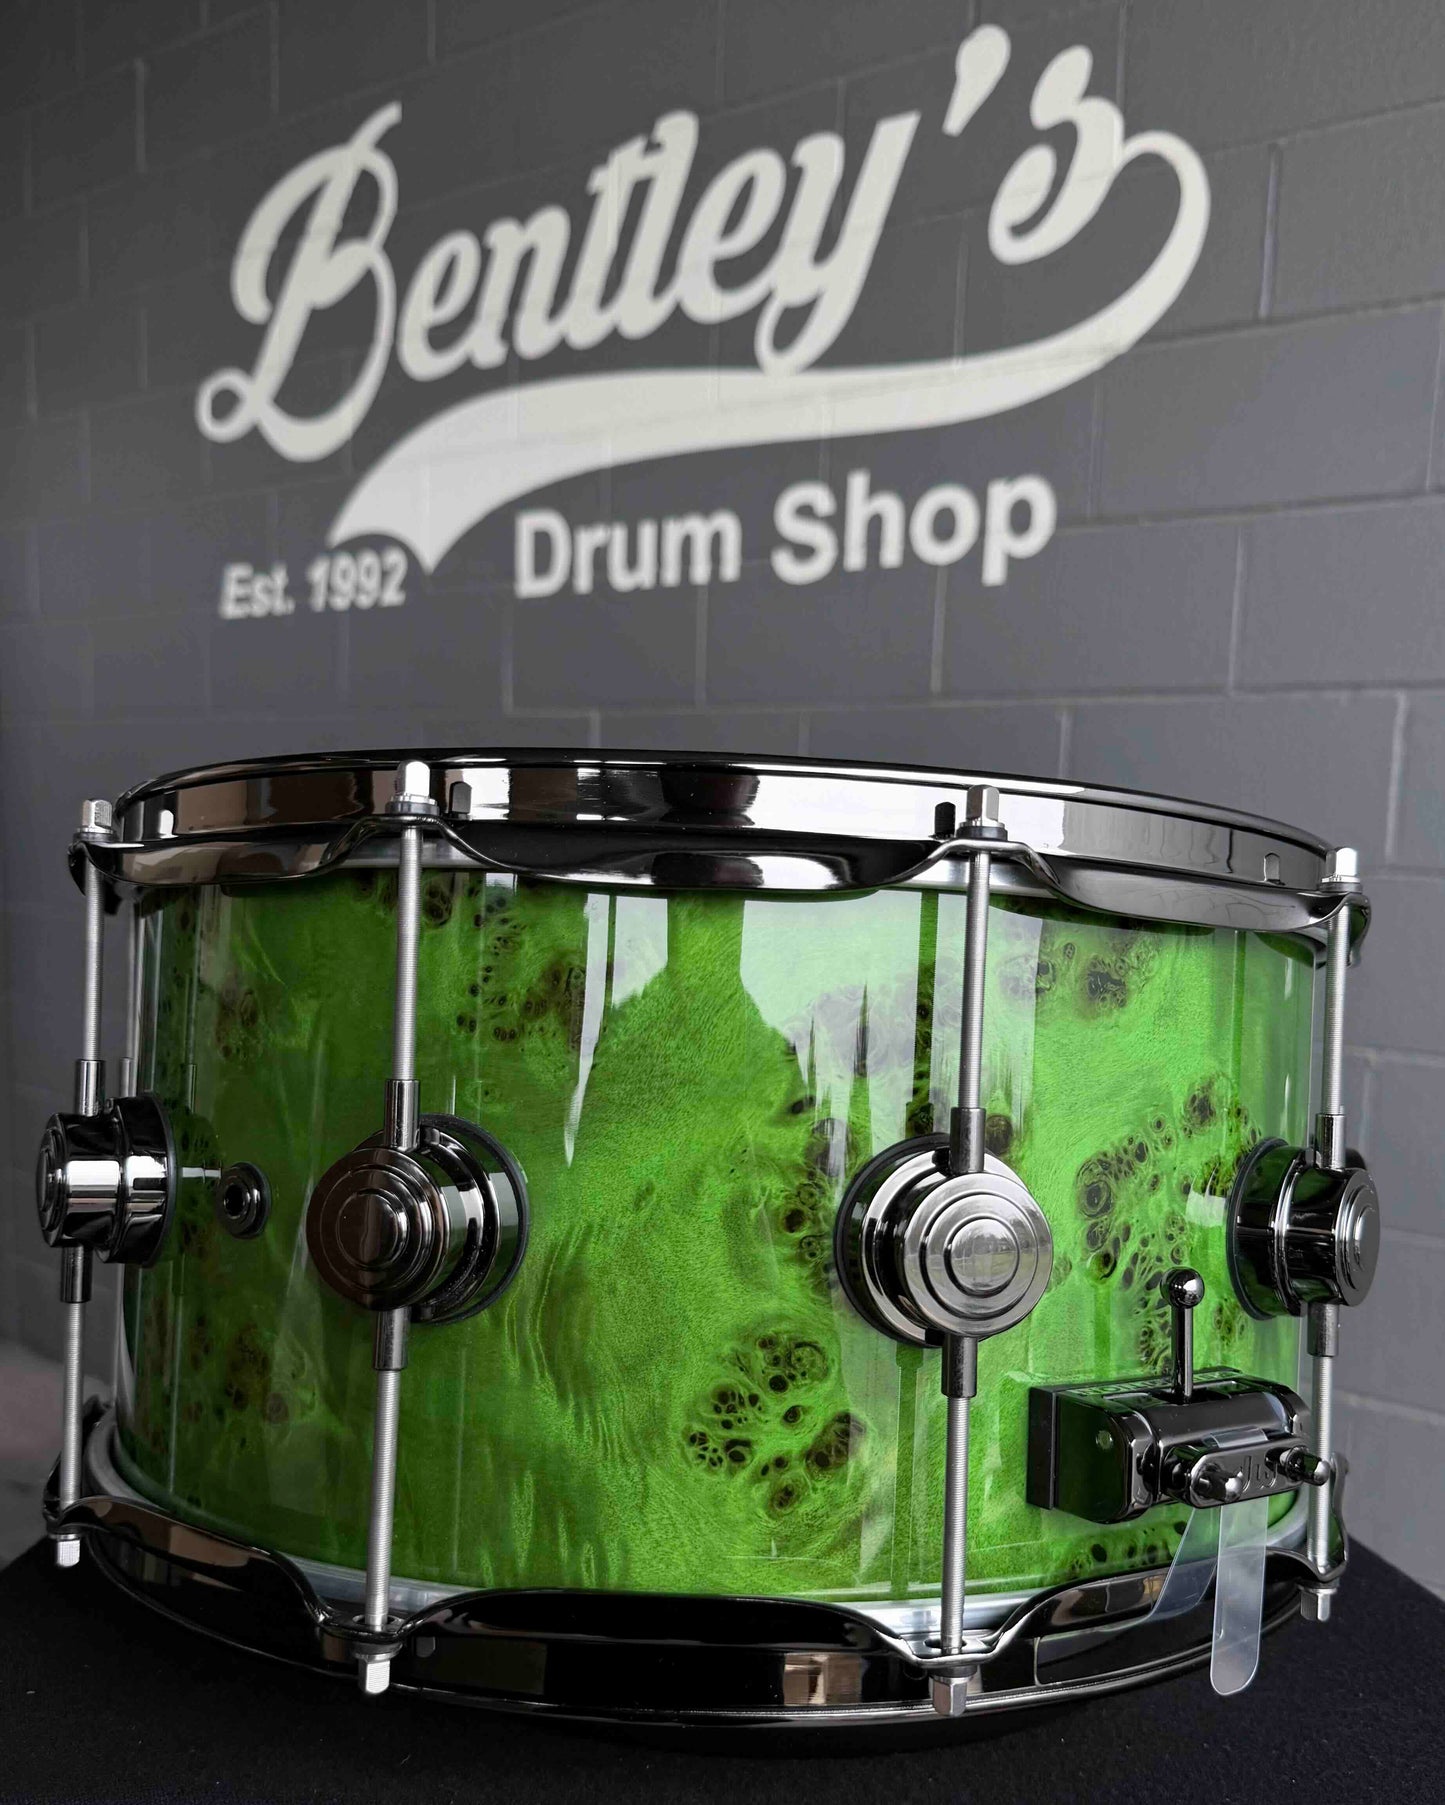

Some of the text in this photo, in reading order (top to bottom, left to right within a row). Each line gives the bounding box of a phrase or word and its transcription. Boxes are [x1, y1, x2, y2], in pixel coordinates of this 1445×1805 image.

[196, 24, 1211, 462] Bentley's
[219, 547, 408, 620] Est. 1992
[514, 469, 1058, 599] Drum Shop
